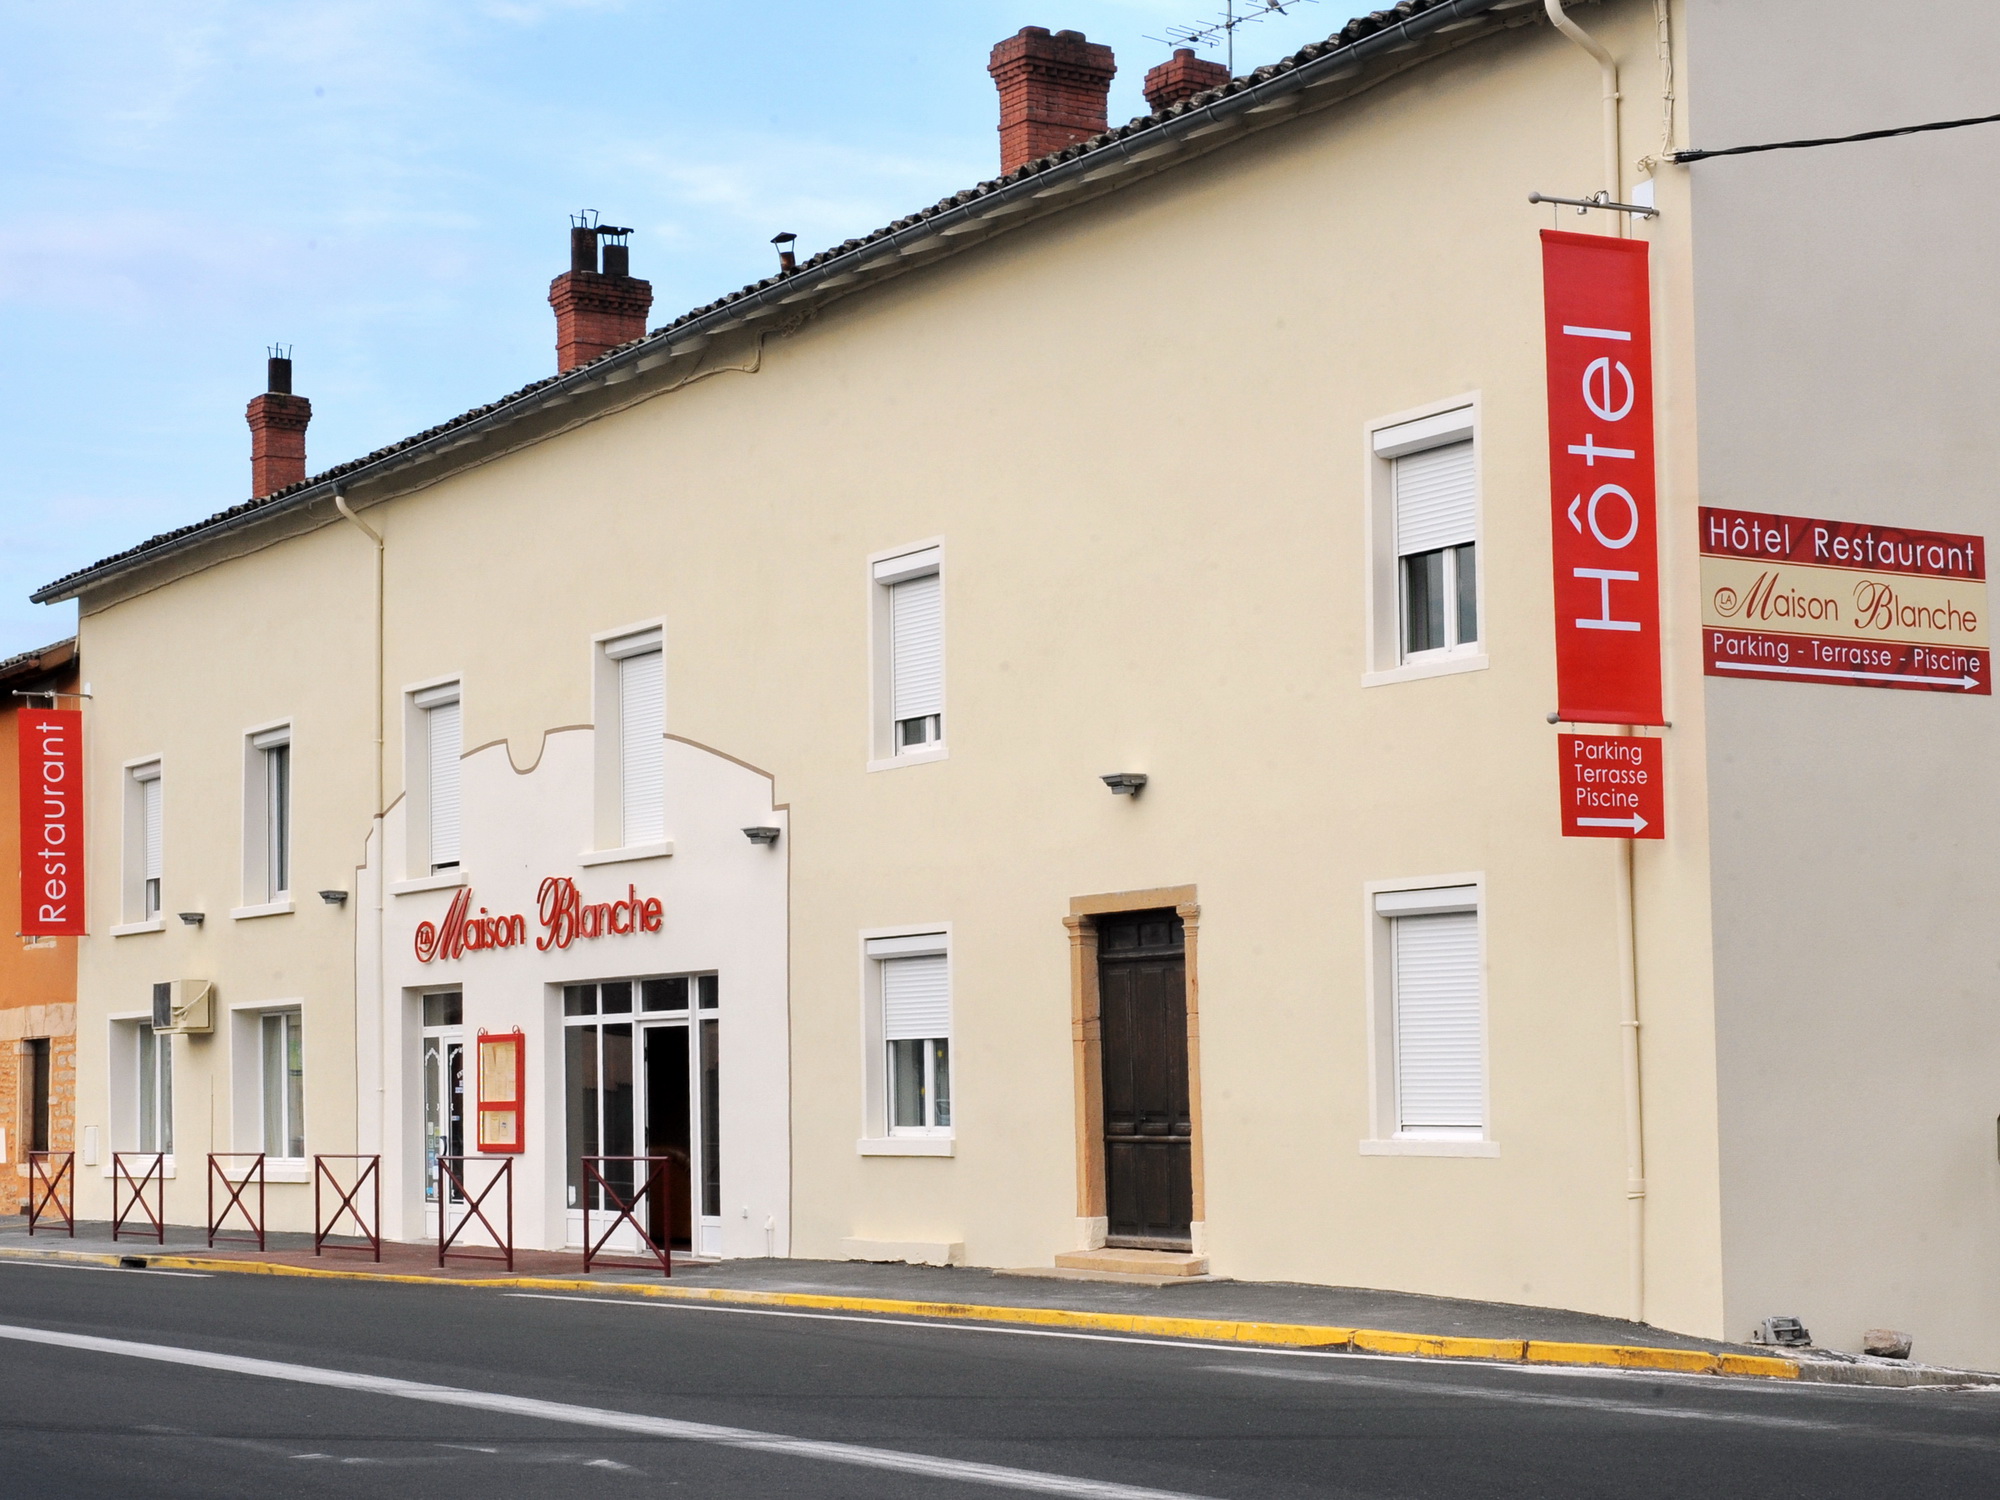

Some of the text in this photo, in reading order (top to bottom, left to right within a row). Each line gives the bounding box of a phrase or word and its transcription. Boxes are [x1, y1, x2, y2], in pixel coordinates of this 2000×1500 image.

[1562, 323, 1642, 633] Hôtel
[1710, 516, 1975, 572] Hôtel Restaurant
[1714, 571, 1839, 621] Maison
[1852, 579, 1978, 633] Blanche
[1713, 633, 1790, 664] Parking
[1811, 640, 1892, 667] Terrasse
[1914, 648, 1981, 673] Piscine
[1574, 740, 1642, 766] Parking
[1574, 763, 1648, 785] Terrasse
[35, 721, 67, 923] Restaurant
[1576, 787, 1640, 808] Piscine
[414, 887, 527, 963] Maison
[536, 876, 664, 952] Blanche
